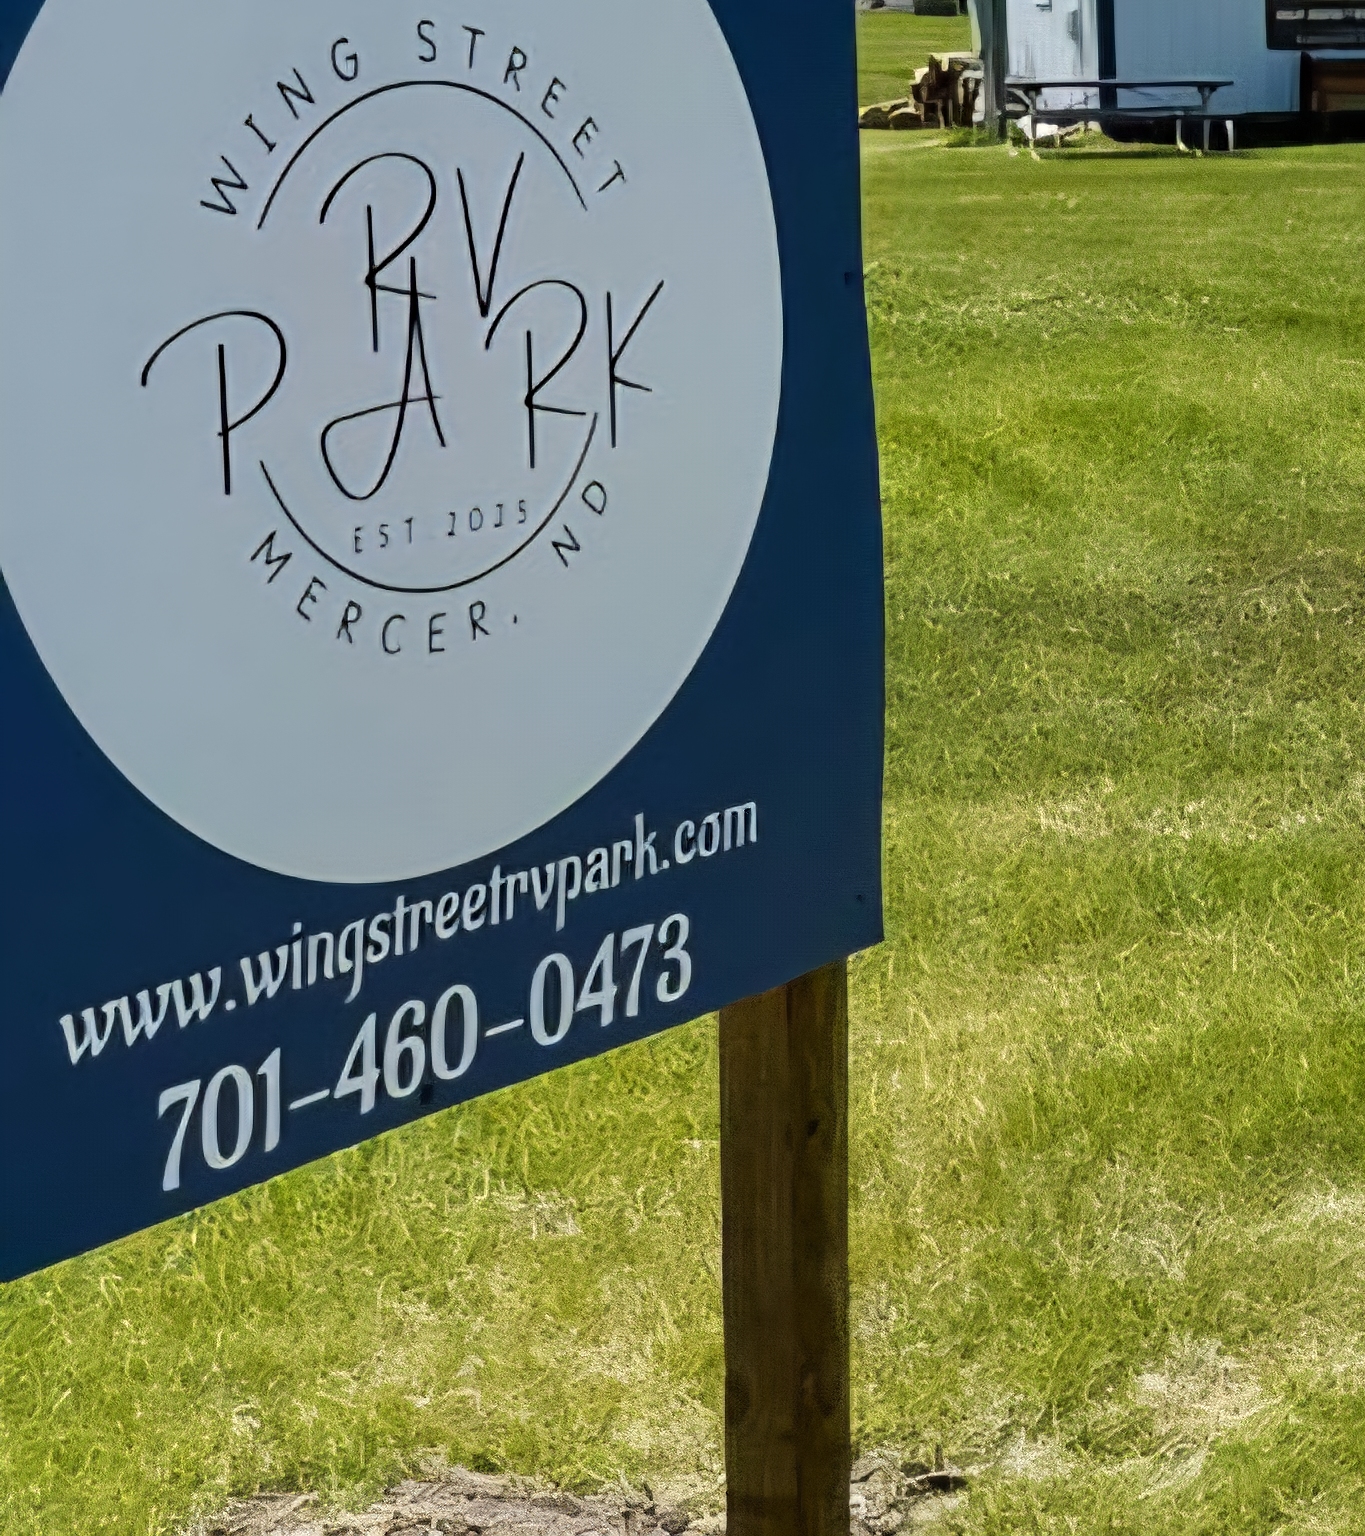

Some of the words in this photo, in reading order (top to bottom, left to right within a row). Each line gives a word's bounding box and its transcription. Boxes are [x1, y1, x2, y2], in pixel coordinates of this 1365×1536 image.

[200, 37, 359, 214] WING
[418, 20, 627, 192] STREET
[320, 152, 525, 351] RV
[141, 257, 664, 500] PARK
[353, 517, 414, 554] EST
[551, 480, 607, 568] ND
[59, 800, 758, 1064] www.wingstreetrvpark.com
[157, 912, 693, 1191] 701-460-0473
